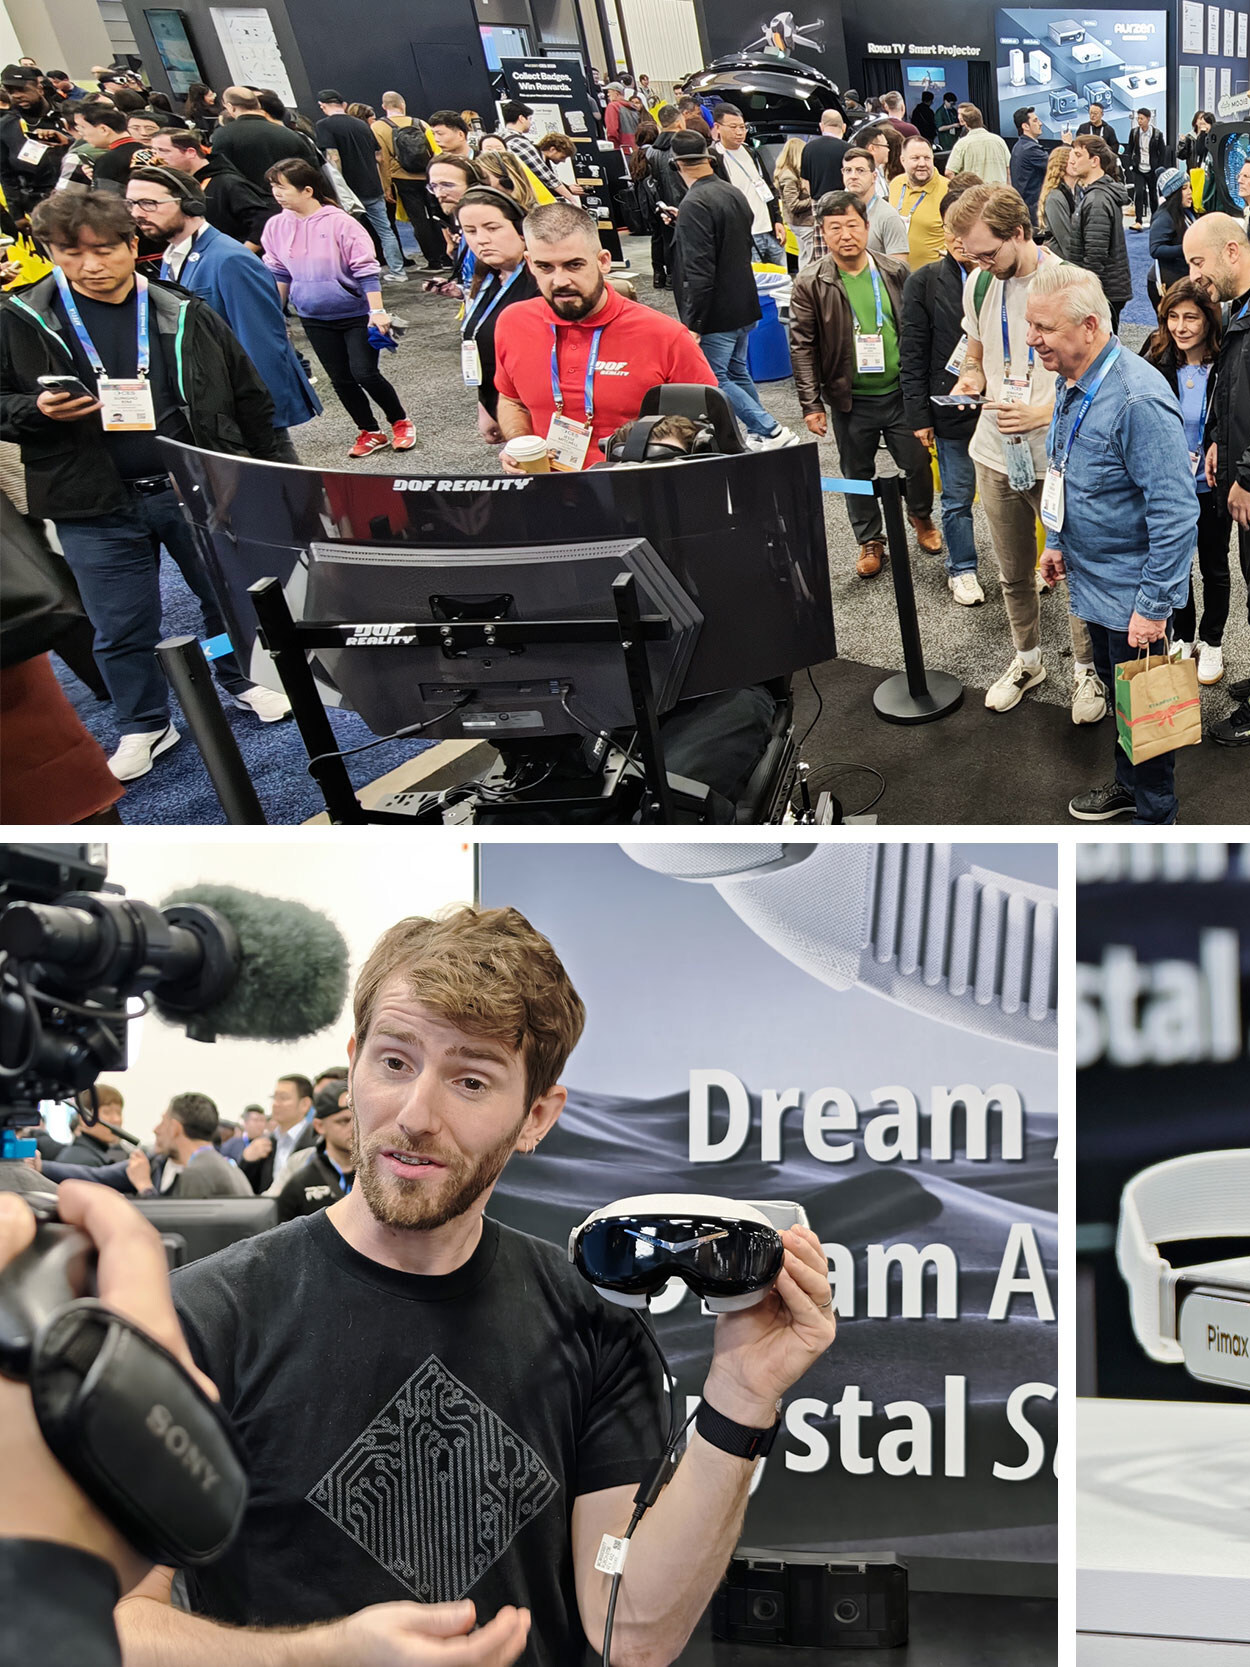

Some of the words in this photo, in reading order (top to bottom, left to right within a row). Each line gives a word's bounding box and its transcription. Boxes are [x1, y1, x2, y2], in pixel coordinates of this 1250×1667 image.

[908, 44, 937, 54] Smart
[937, 45, 981, 57] Projector
[512, 71, 541, 80] Collect
[518, 82, 535, 91] Win
[392, 479, 436, 492] DOF
[436, 477, 533, 492] REALITY
[353, 624, 403, 637] DOF
[345, 635, 417, 646] REALITY
[688, 1068, 1024, 1163] Dream
[1207, 1323, 1250, 1358] Pimax
[145, 1404, 221, 1492] SONY
